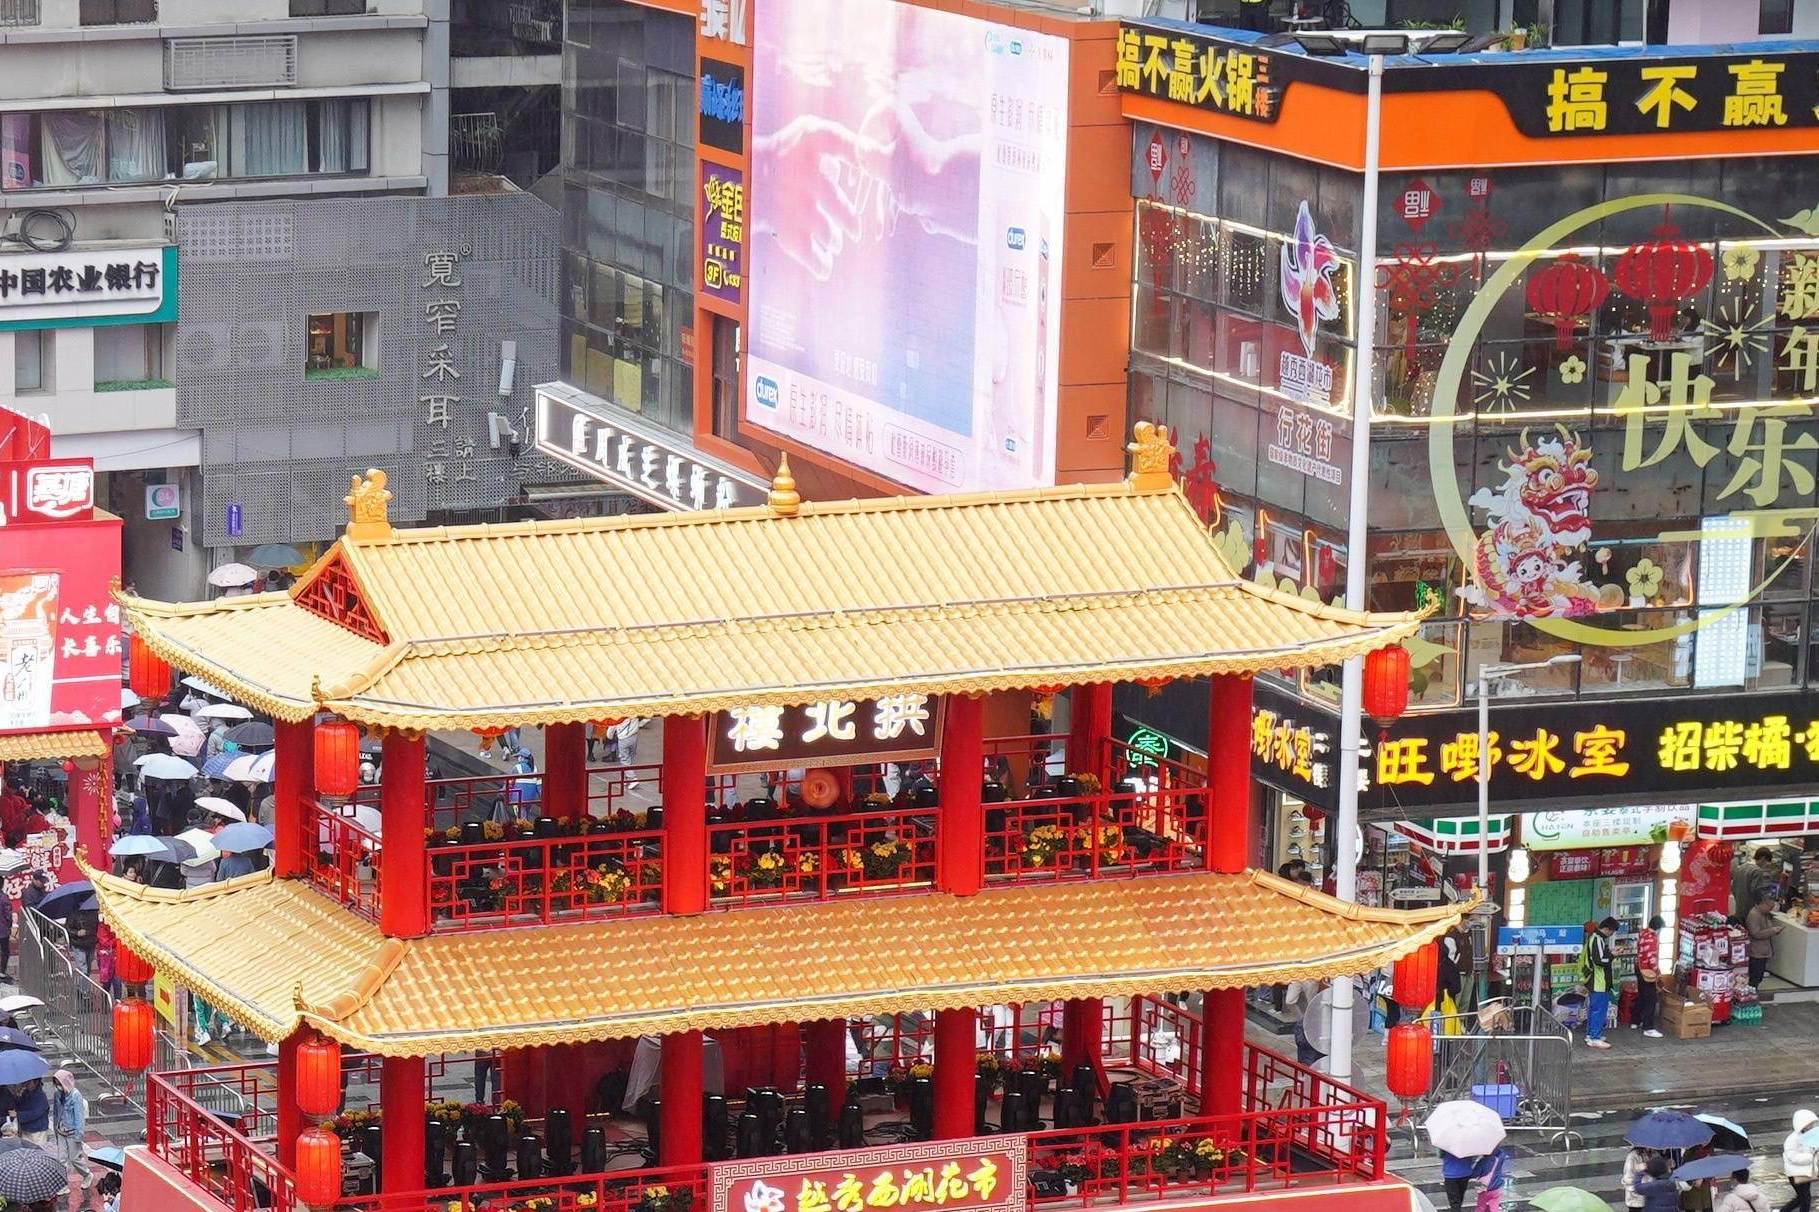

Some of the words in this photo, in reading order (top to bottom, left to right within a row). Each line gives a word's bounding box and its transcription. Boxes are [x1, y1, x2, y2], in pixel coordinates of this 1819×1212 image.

[1116, 29, 1252, 115] 搞不赢火锅
[1546, 60, 1819, 133] 搞不赢
[1278, 406, 1333, 461] 行花街
[1251, 708, 1313, 783] 嘢冰室
